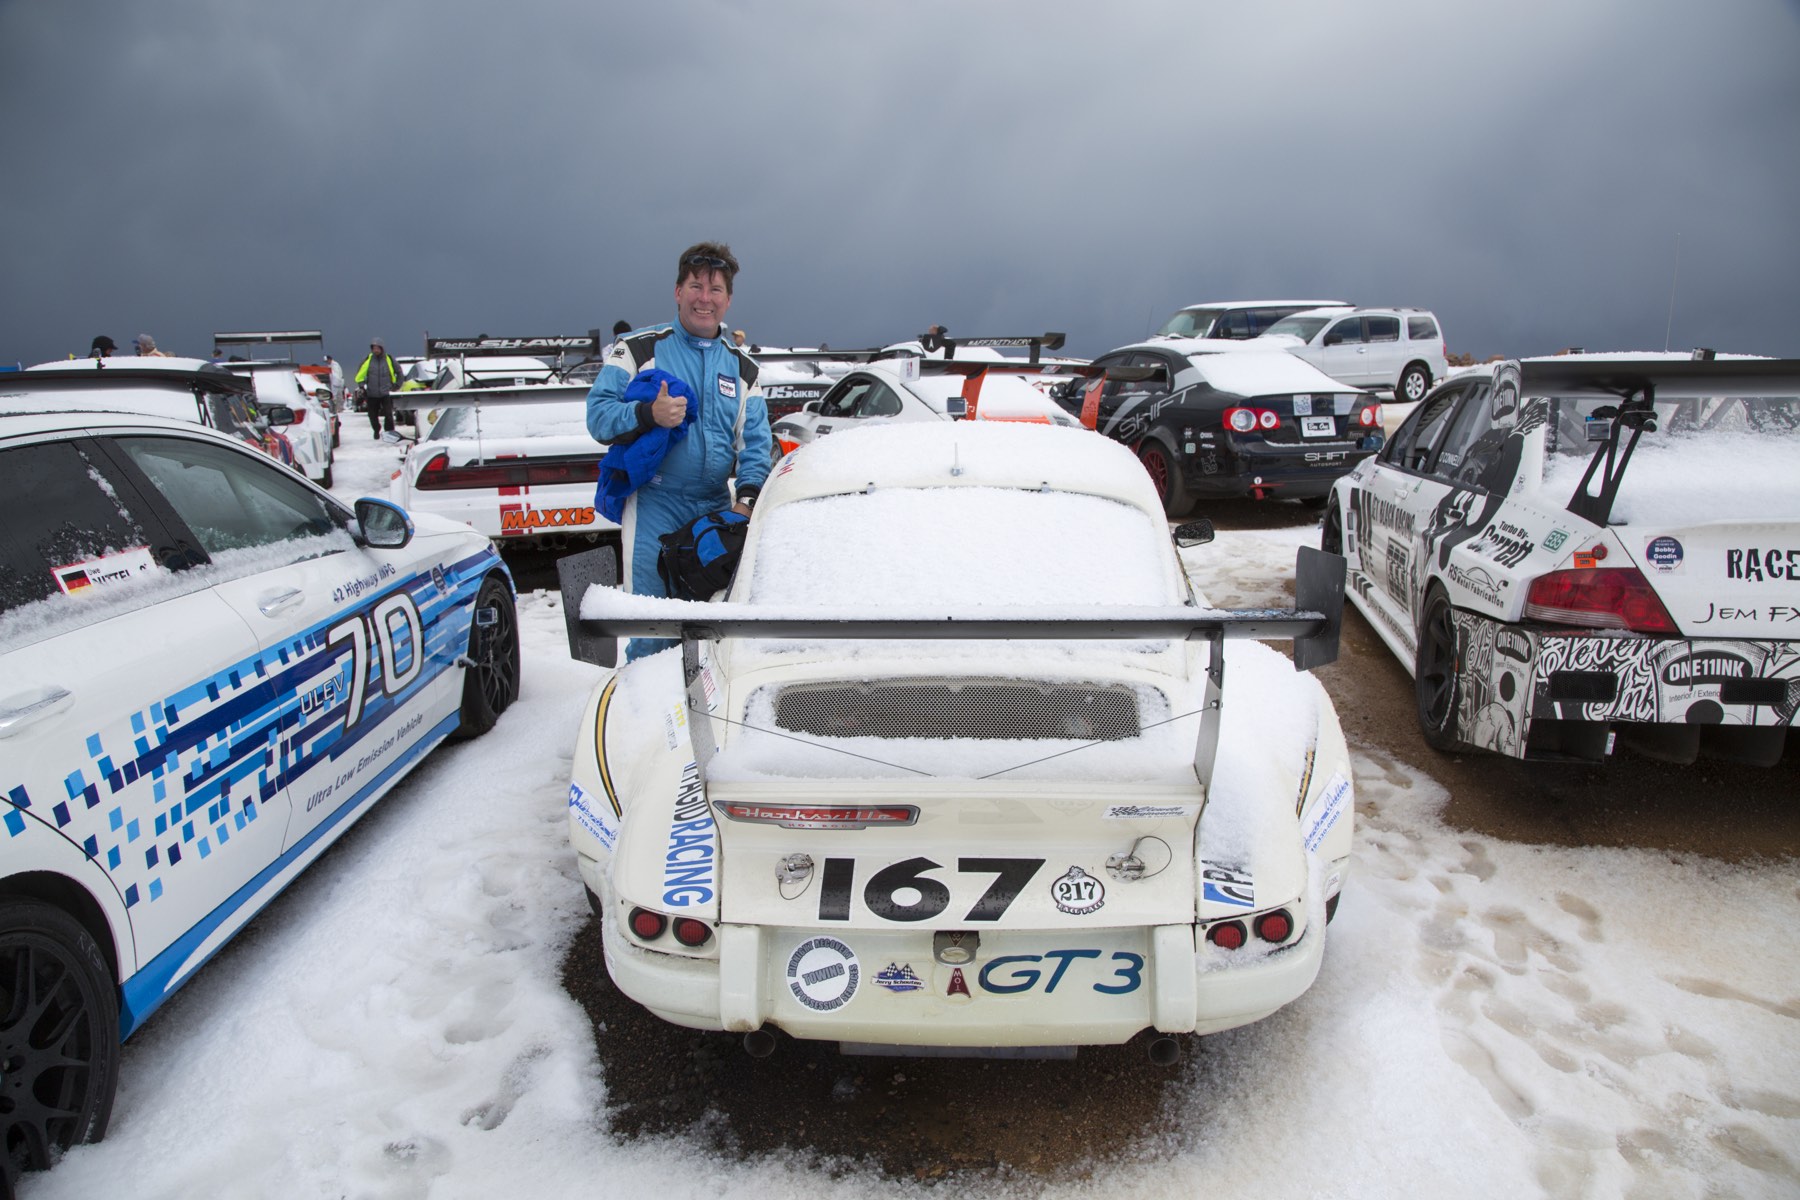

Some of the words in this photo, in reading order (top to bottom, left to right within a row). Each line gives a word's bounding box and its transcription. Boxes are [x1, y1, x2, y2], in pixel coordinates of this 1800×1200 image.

[434, 341, 477, 349] Electric
[480, 338, 593, 349] SH-AWD
[793, 390, 820, 398] GIKEN
[1119, 384, 1198, 439] SHIFT
[1304, 451, 1350, 462] SHIFT
[501, 507, 596, 530] MAXXIS
[1499, 521, 1518, 535] Turbo
[1543, 530, 1568, 551] E85
[333, 588, 344, 603] 42
[343, 573, 379, 597] Highway
[378, 562, 396, 580] MPG
[1470, 583, 1504, 608] Fabrication
[1692, 602, 1757, 623] JEM
[325, 588, 425, 738] 70
[300, 671, 346, 716] ULEV
[1669, 692, 1692, 703] Interior
[1698, 689, 1721, 698] Exterio
[306, 785, 332, 812] Ultra
[335, 766, 355, 788] Low
[356, 737, 395, 773] Emission
[396, 712, 423, 742] Vehicle
[734, 806, 896, 821] Hanksville
[662, 817, 714, 906] RACING
[818, 857, 1046, 922] 167
[1059, 882, 1095, 901] 217
[787, 940, 815, 978] MIDNIGHT
[813, 938, 855, 960] RECOVERY
[802, 962, 846, 986] TOWING
[978, 949, 1103, 994] GT
[1093, 951, 1145, 995] 3
[790, 981, 844, 1011] REPOSSESSION
[839, 963, 859, 1003] SERVICES
